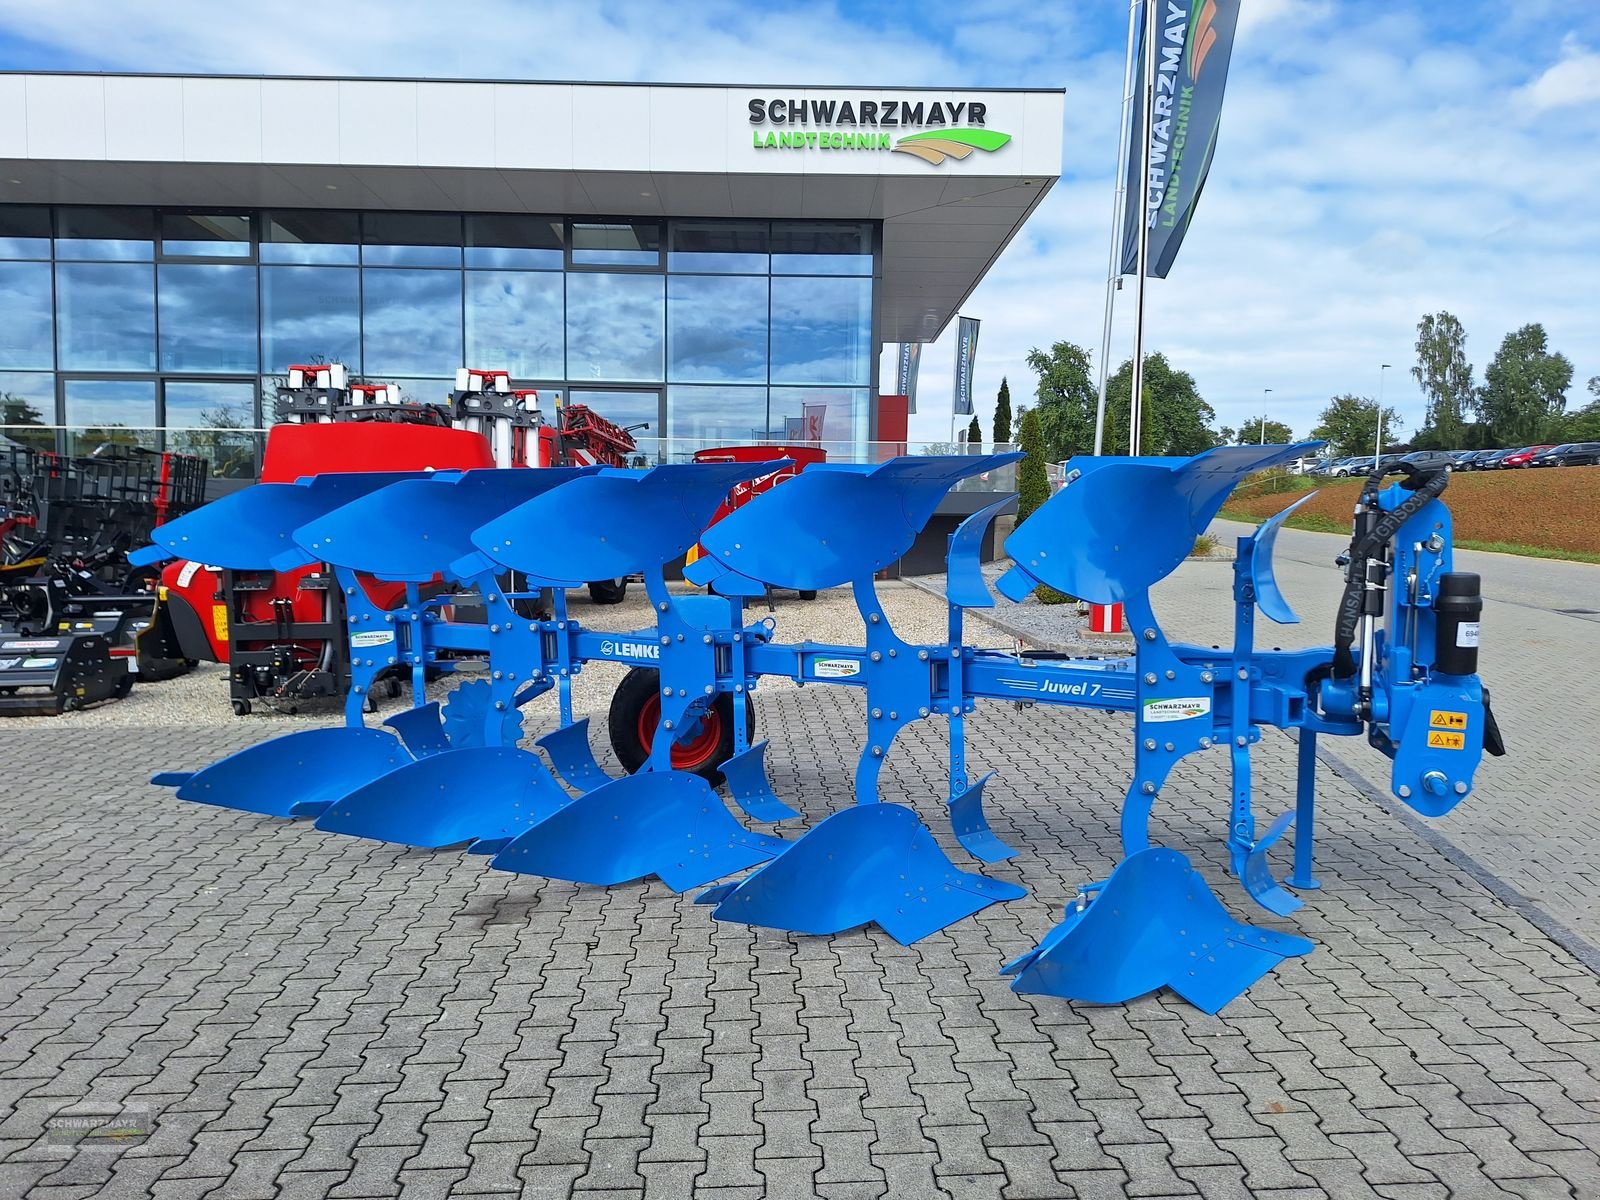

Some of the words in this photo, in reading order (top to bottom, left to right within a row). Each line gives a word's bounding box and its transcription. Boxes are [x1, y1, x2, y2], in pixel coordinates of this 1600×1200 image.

[748, 98, 987, 127] SCHWARZMAYR
[753, 130, 891, 150] LANDTECHNIK
[1162, 85, 1194, 228] LANDTECHNIK
[960, 336, 969, 402] SCHWARZMAYR
[1040, 679, 1087, 696] Juwel
[1089, 684, 1101, 697] 7
